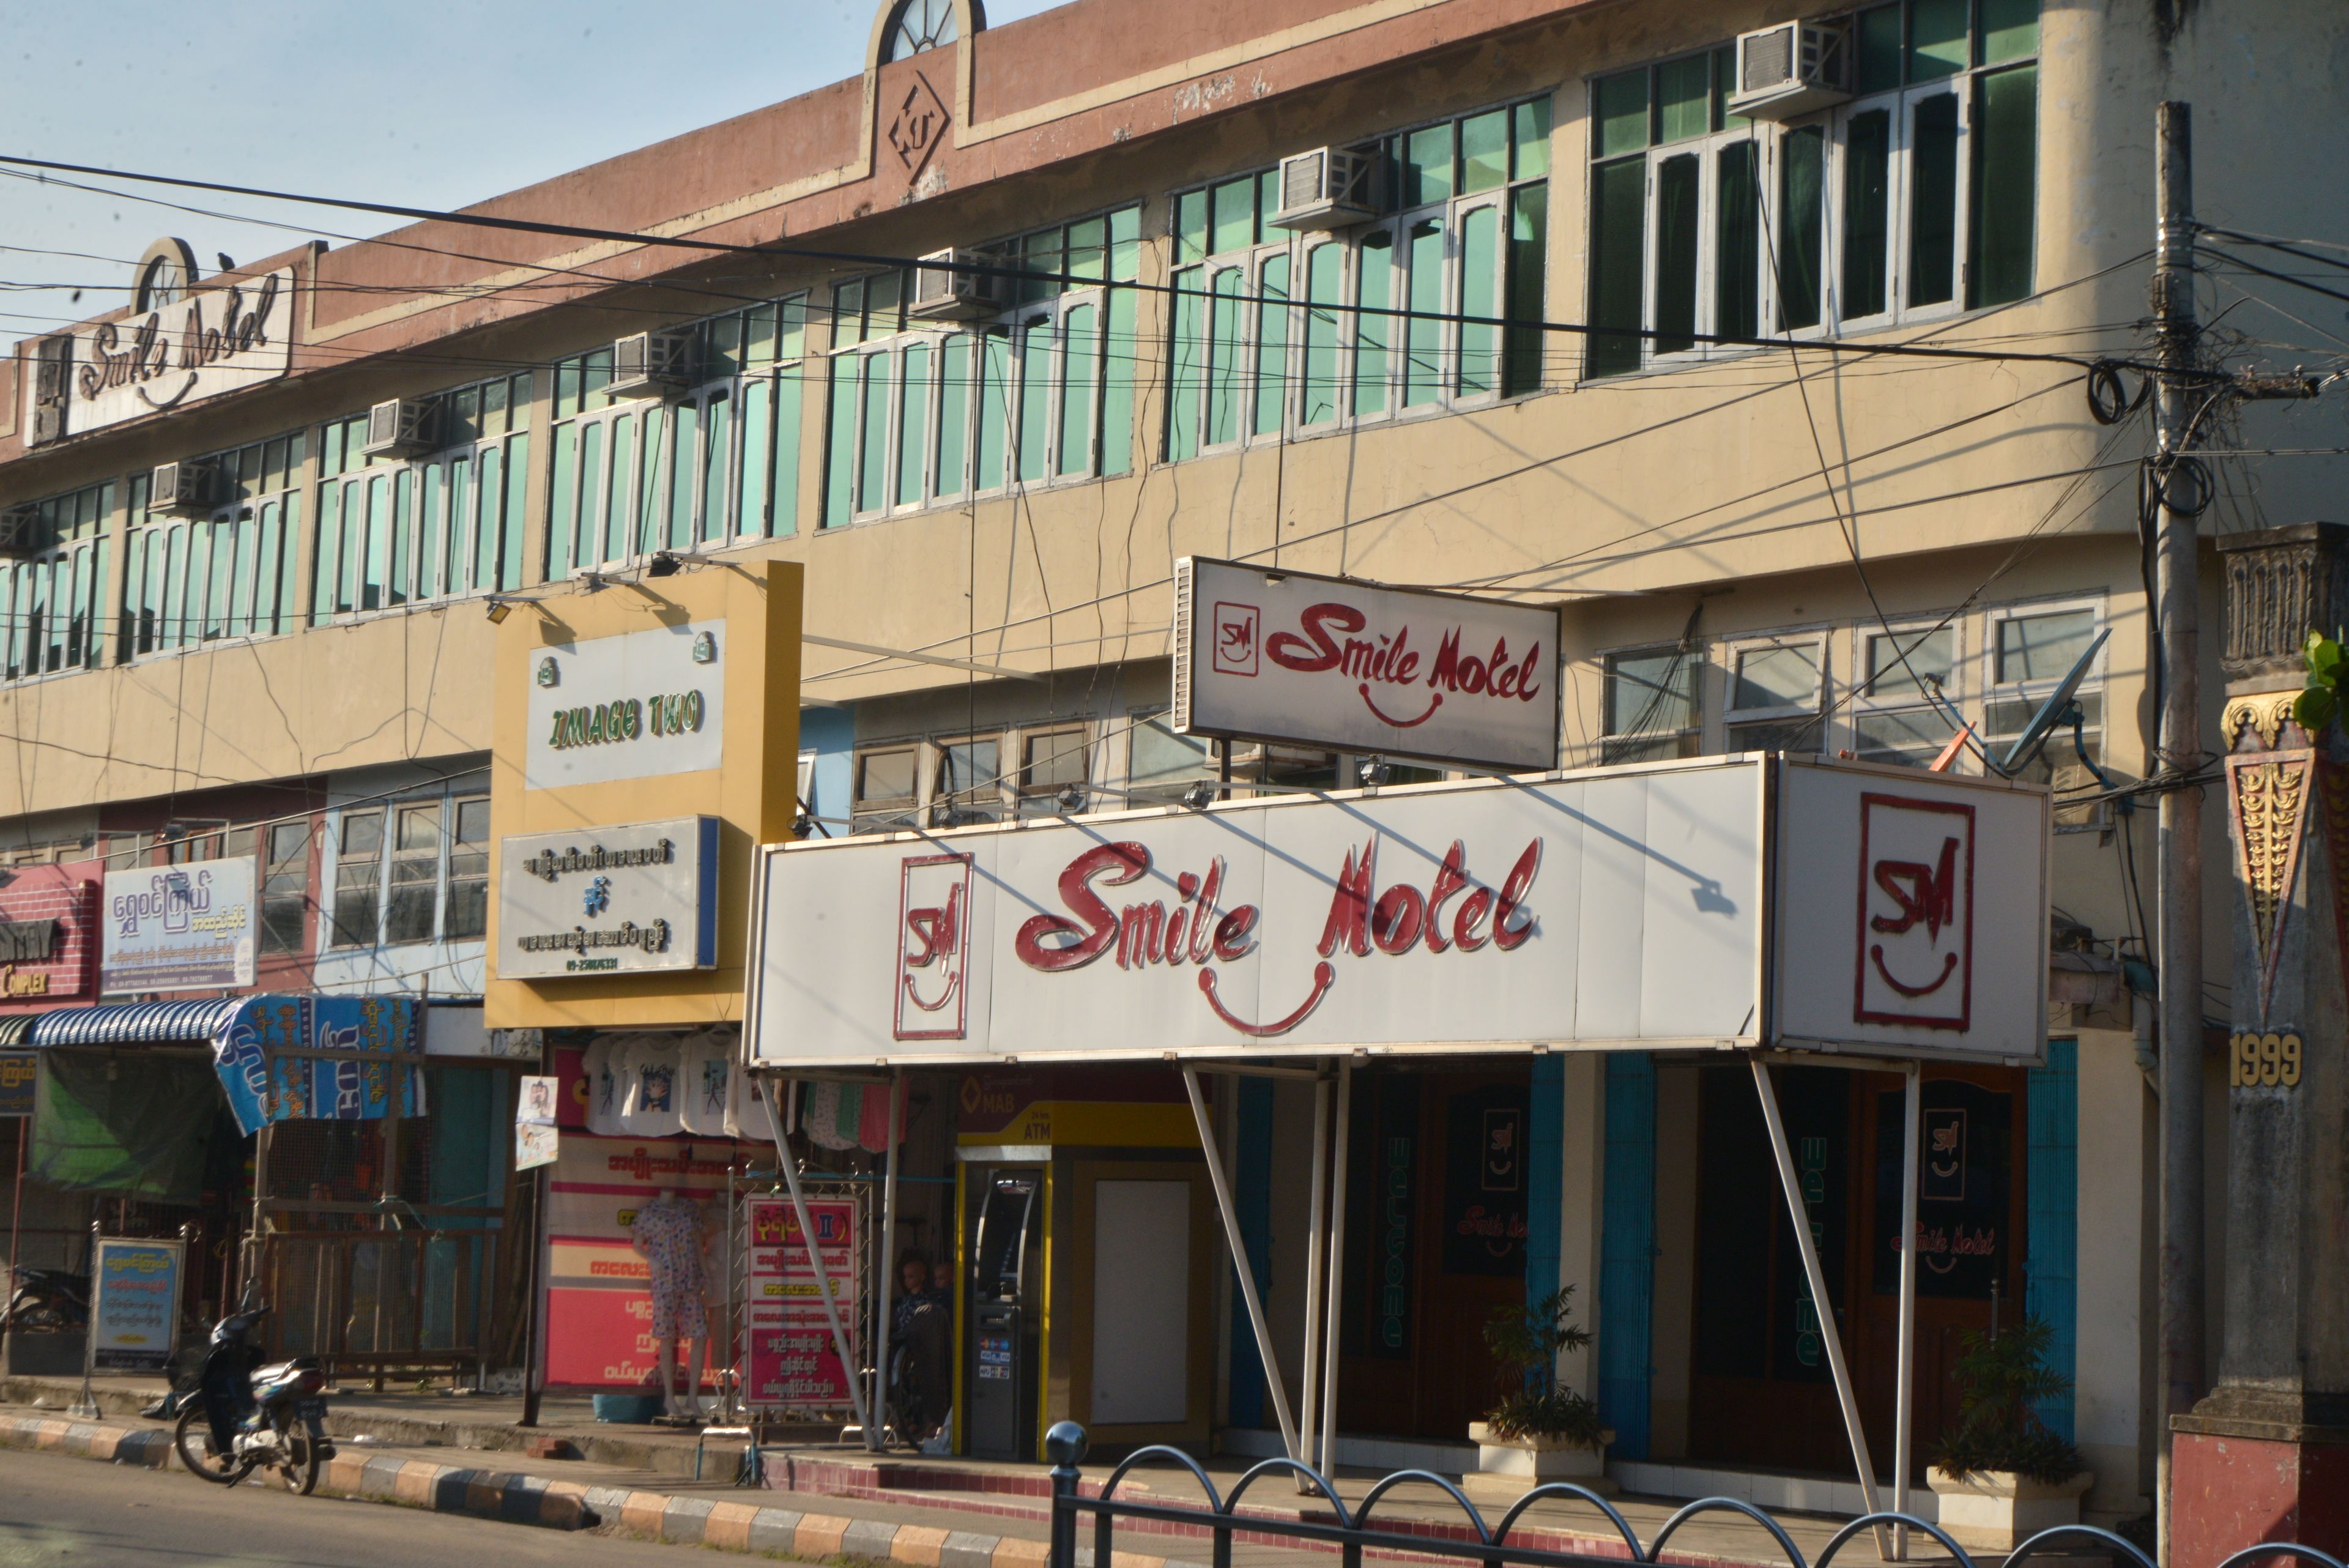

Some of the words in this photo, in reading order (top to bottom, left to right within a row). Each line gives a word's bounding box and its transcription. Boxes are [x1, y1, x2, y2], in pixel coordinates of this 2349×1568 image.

[78, 312, 169, 401] Smile
[177, 273, 279, 370] Motel
[1265, 603, 1420, 685] Smile
[1426, 624, 1541, 702] Motel
[548, 698, 638, 748] IMAGE
[648, 689, 700, 735] TWO
[1014, 841, 1260, 972] Smile
[1316, 831, 1542, 957] Motel
[2228, 1032, 2303, 1088] 1999
[1024, 1123, 1051, 1140] ATM
[1950, 1223, 1996, 1256] Motel
